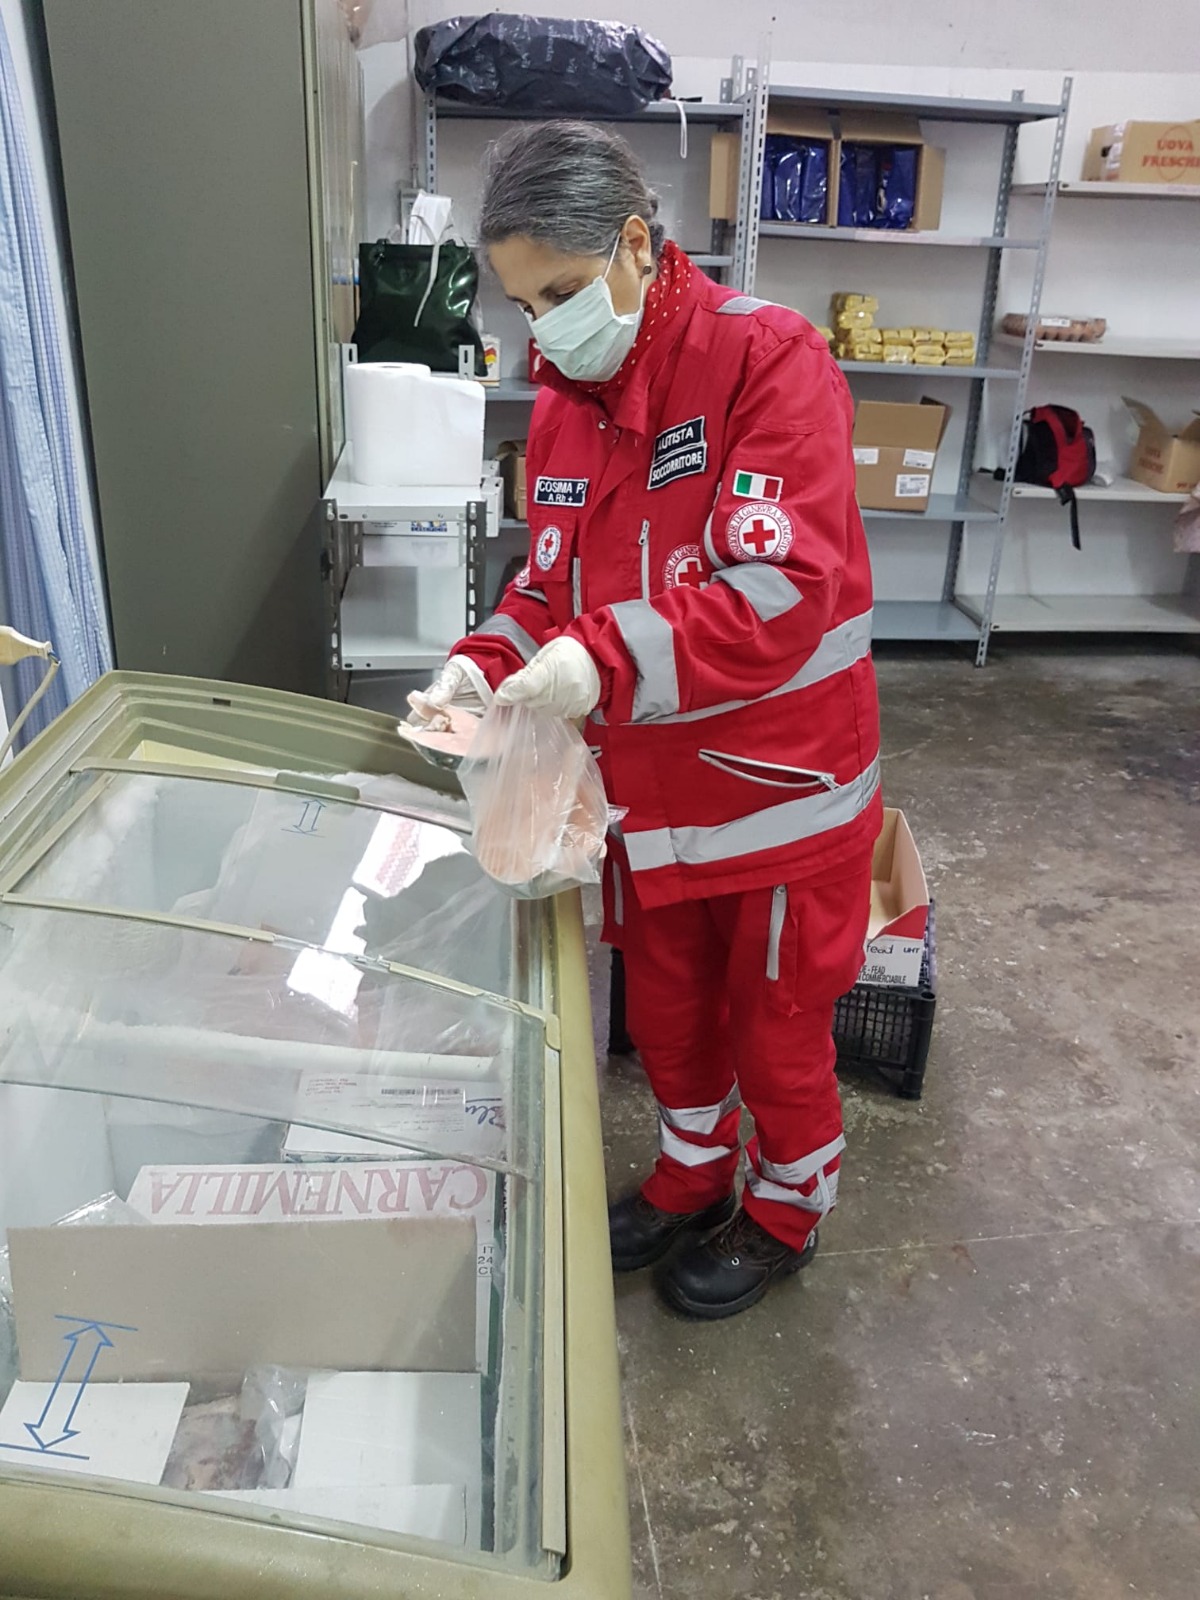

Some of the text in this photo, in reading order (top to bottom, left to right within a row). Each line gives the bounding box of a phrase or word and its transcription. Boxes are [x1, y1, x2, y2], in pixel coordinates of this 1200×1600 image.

[1157, 140, 1194, 151] UOVA
[657, 426, 694, 451] AUTISTA
[652, 451, 702, 481] SOCCORRITORE
[539, 480, 572, 493] COSIMA
[548, 493, 554, 502] A
[866, 944, 920, 954] fead UHT
[871, 965, 886, 975] FEAD
[862, 973, 907, 984] COMMERCIABILE
[150, 1165, 488, 1216] CARNEMILIA
